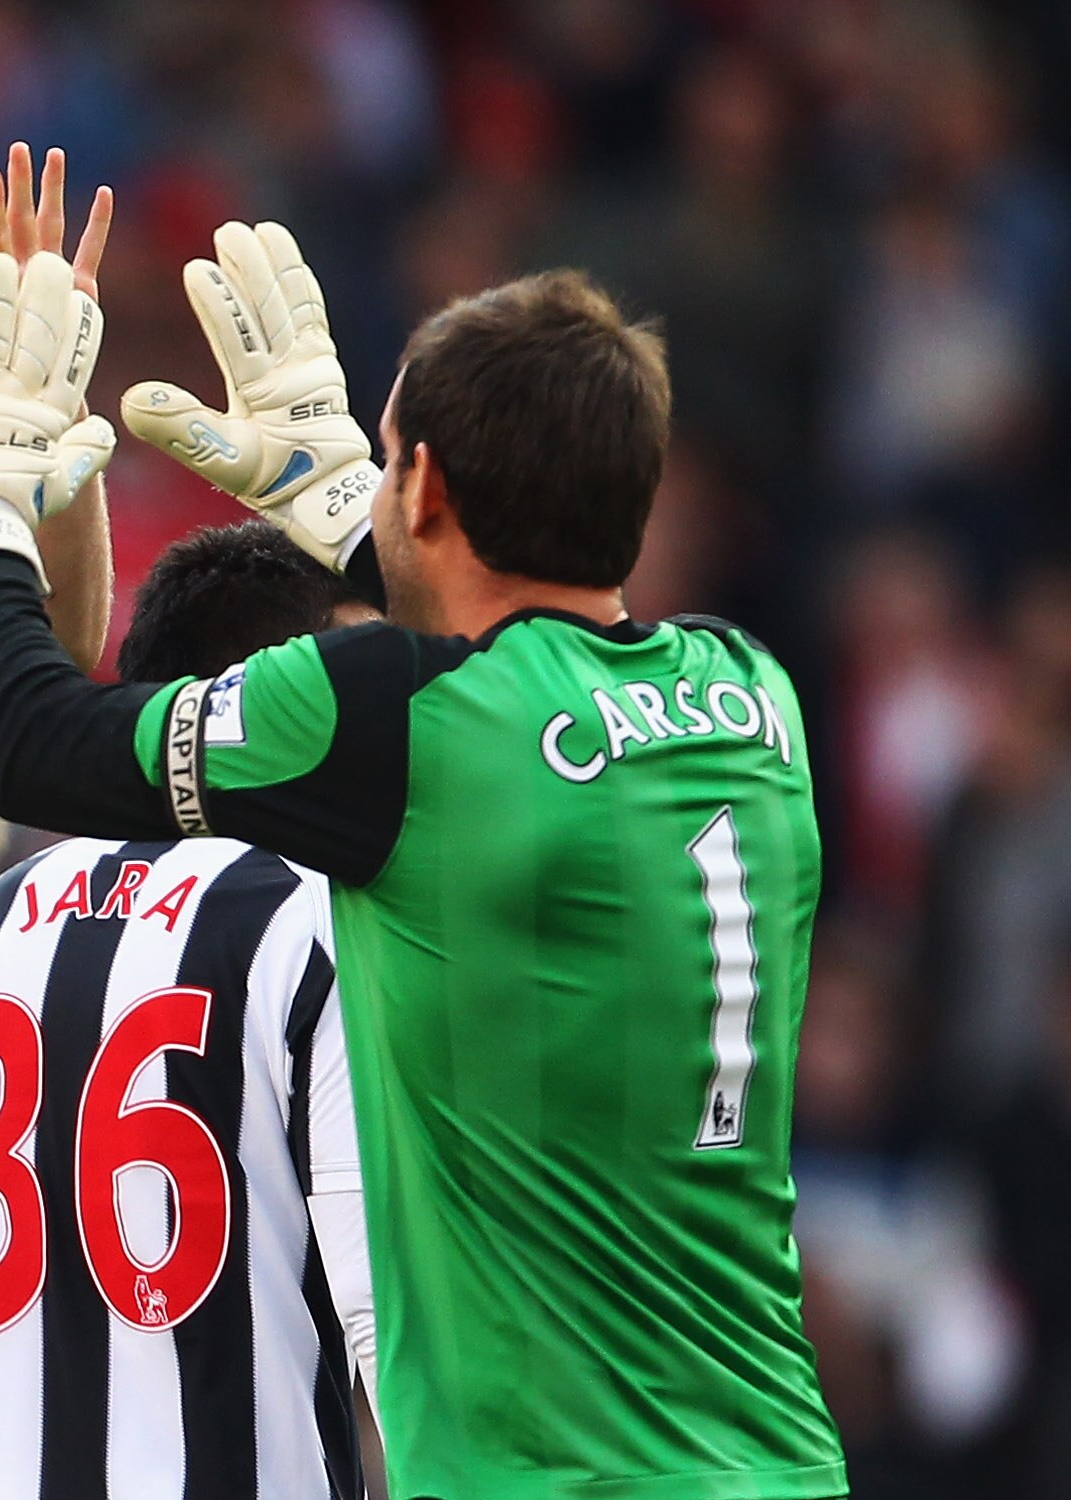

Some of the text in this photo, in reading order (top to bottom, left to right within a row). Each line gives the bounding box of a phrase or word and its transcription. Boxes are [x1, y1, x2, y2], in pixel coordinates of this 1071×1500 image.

[66, 300, 92, 386] SELLS
[326, 471, 376, 499] SCO
[326, 483, 380, 517] CAR
[172, 698, 208, 836] CAPTAIN
[541, 678, 791, 784] CARSON
[18, 861, 200, 934] JARA
[685, 803, 759, 1150] 1
